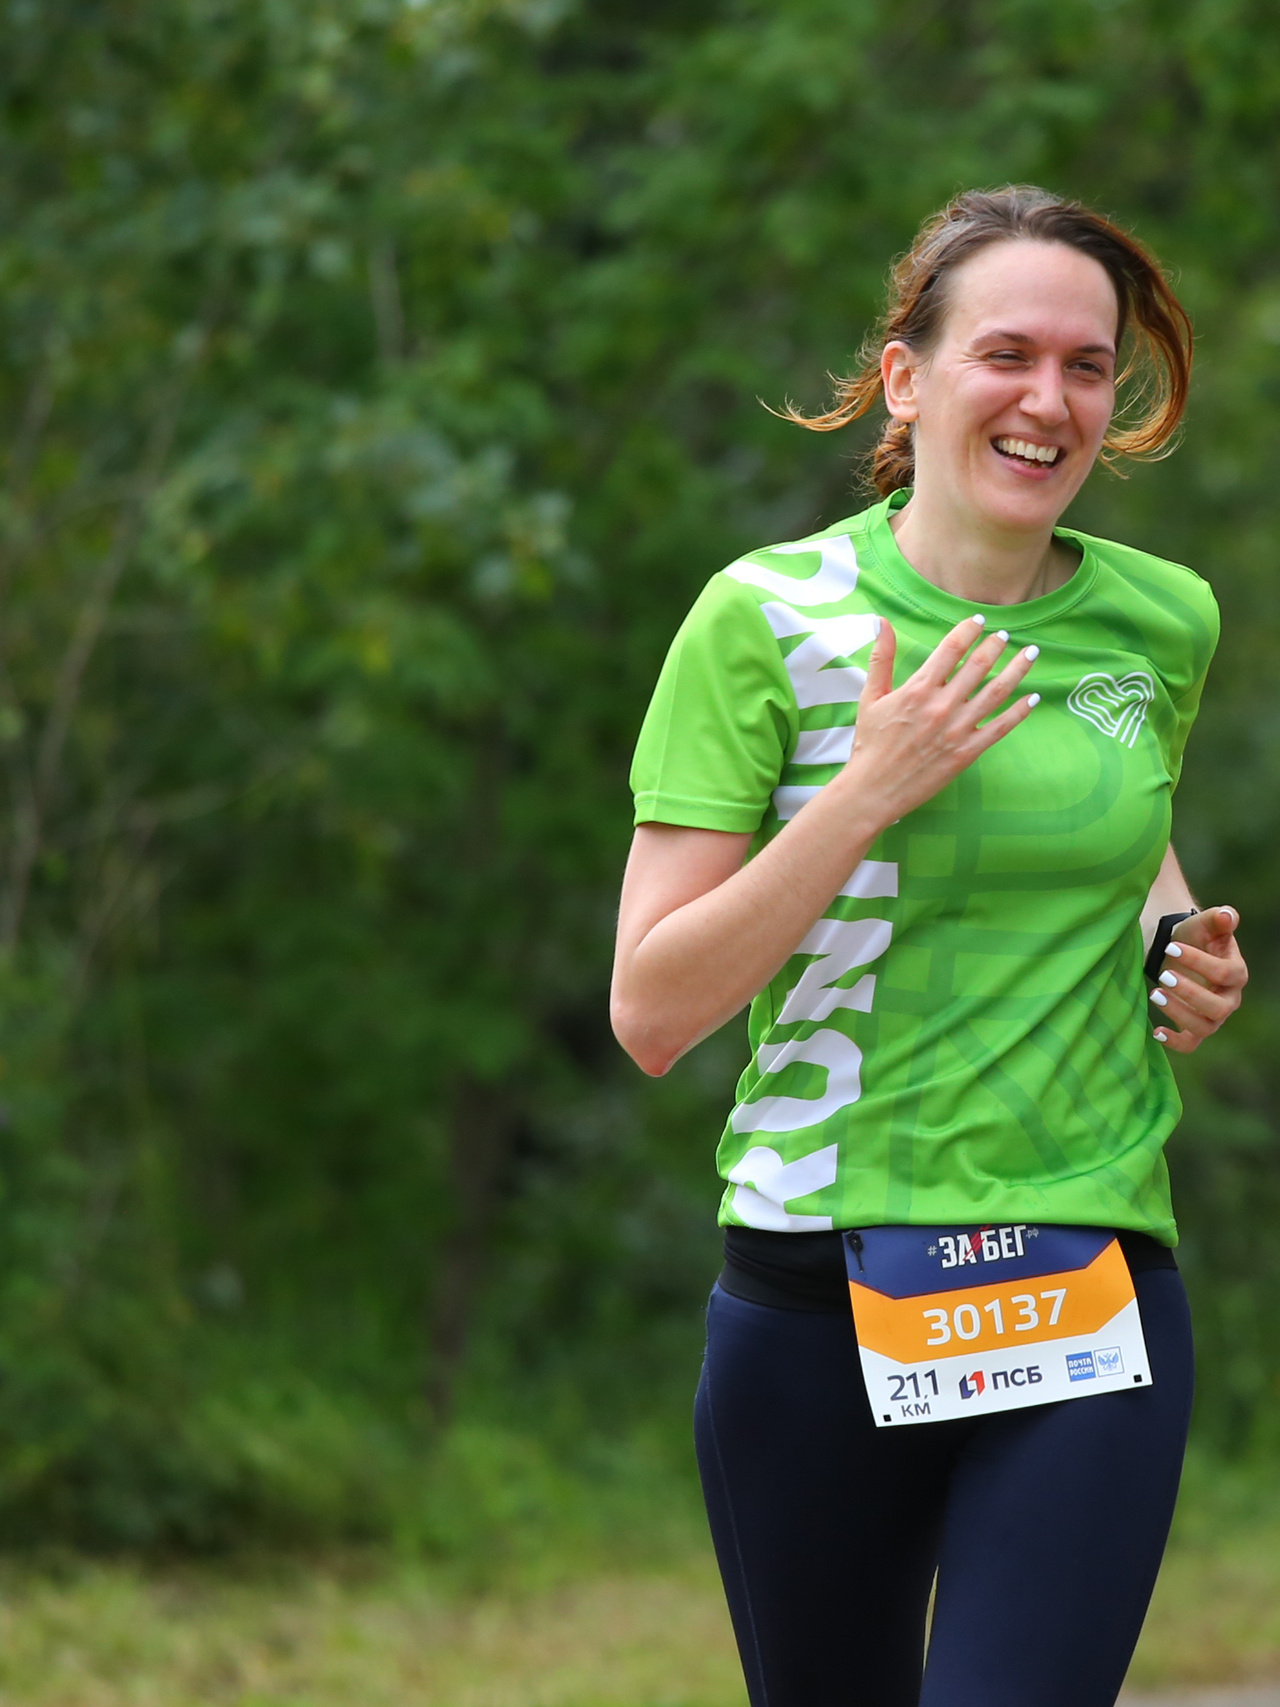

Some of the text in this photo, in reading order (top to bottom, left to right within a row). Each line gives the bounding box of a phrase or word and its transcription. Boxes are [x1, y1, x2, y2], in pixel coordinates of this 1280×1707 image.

[922, 1288, 1067, 1346] 30137
[1068, 1357, 1092, 1369] ПОЧТА
[1070, 1366, 1094, 1377] РОССИИ
[886, 1368, 940, 1401] 21,1
[991, 1365, 1043, 1391] ПСБ
[900, 1402, 932, 1418] КМ
